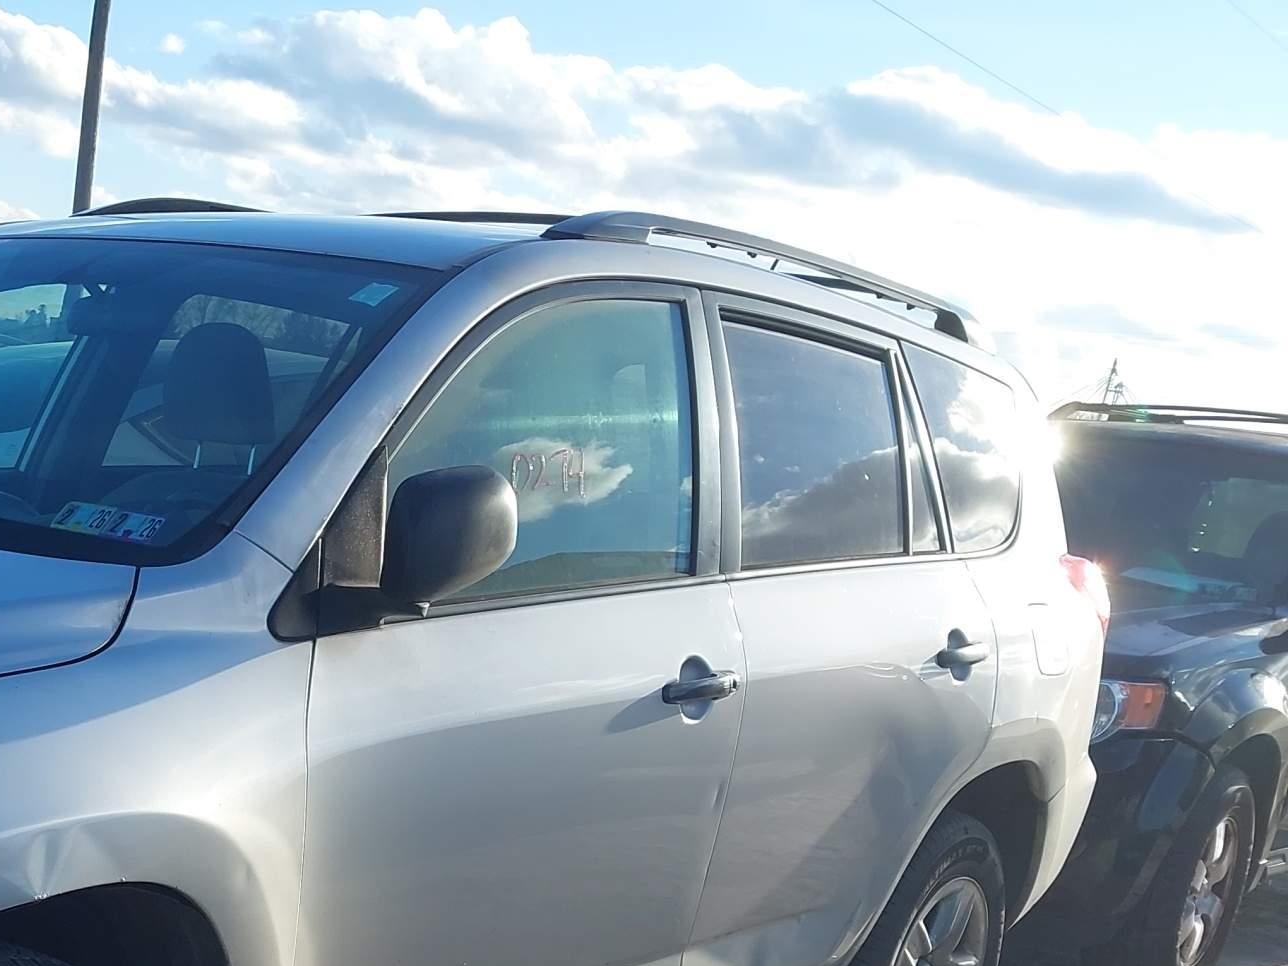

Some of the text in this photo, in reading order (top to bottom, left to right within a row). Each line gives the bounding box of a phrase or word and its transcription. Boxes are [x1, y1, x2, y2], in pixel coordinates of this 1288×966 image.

[60, 508, 111, 529] 2 26
[111, 514, 161, 538] 2 26
